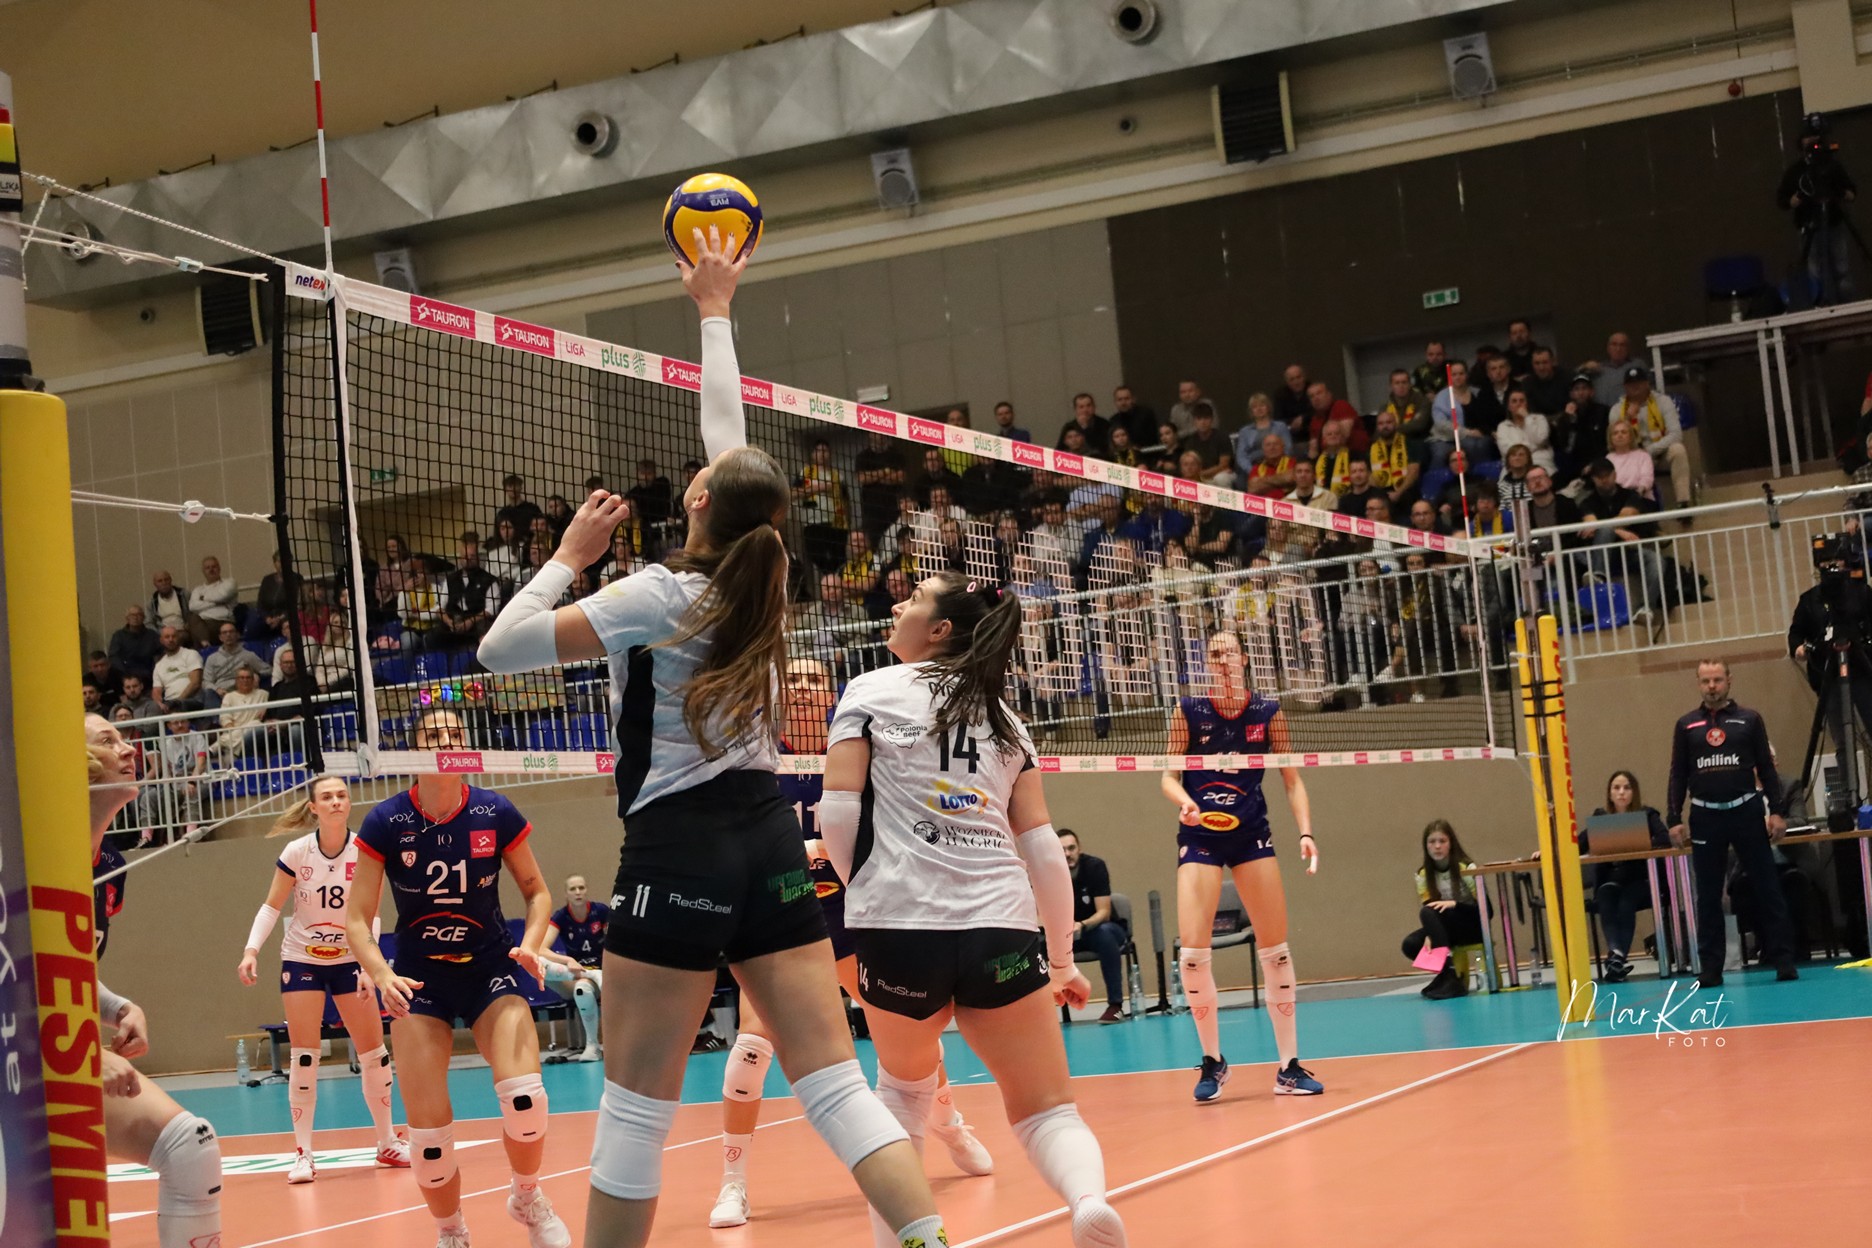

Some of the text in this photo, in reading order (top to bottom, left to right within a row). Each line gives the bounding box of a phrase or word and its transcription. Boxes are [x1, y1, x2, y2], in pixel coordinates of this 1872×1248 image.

[431, 311, 470, 330] TAURON
[513, 331, 549, 349] TAURON
[601, 345, 629, 369] plus
[677, 367, 702, 384] TAURO
[742, 384, 769, 400] TAURON
[809, 395, 832, 416] plus
[868, 413, 894, 429] TAURON
[917, 425, 943, 440] TAURON
[973, 434, 992, 452] plus
[1021, 447, 1043, 462] TAURON
[938, 721, 980, 774] 14
[451, 754, 545, 771] TAURON plus
[794, 757, 812, 772] plus
[1696, 753, 1740, 769] Unilink
[939, 793, 978, 810] LOTTO
[1203, 791, 1238, 806] PGE
[399, 835, 416, 843] PGE
[425, 859, 468, 895] 21
[316, 885, 345, 909] 18
[632, 884, 651, 918] 11
[669, 893, 733, 914] RedSteel
[422, 926, 469, 942] PGE
[582, 940, 592, 952] 4
[488, 974, 518, 993] 21
[858, 962, 869, 992] 14
[877, 979, 927, 999] RedSteel
[30, 884, 111, 1248] PESME
